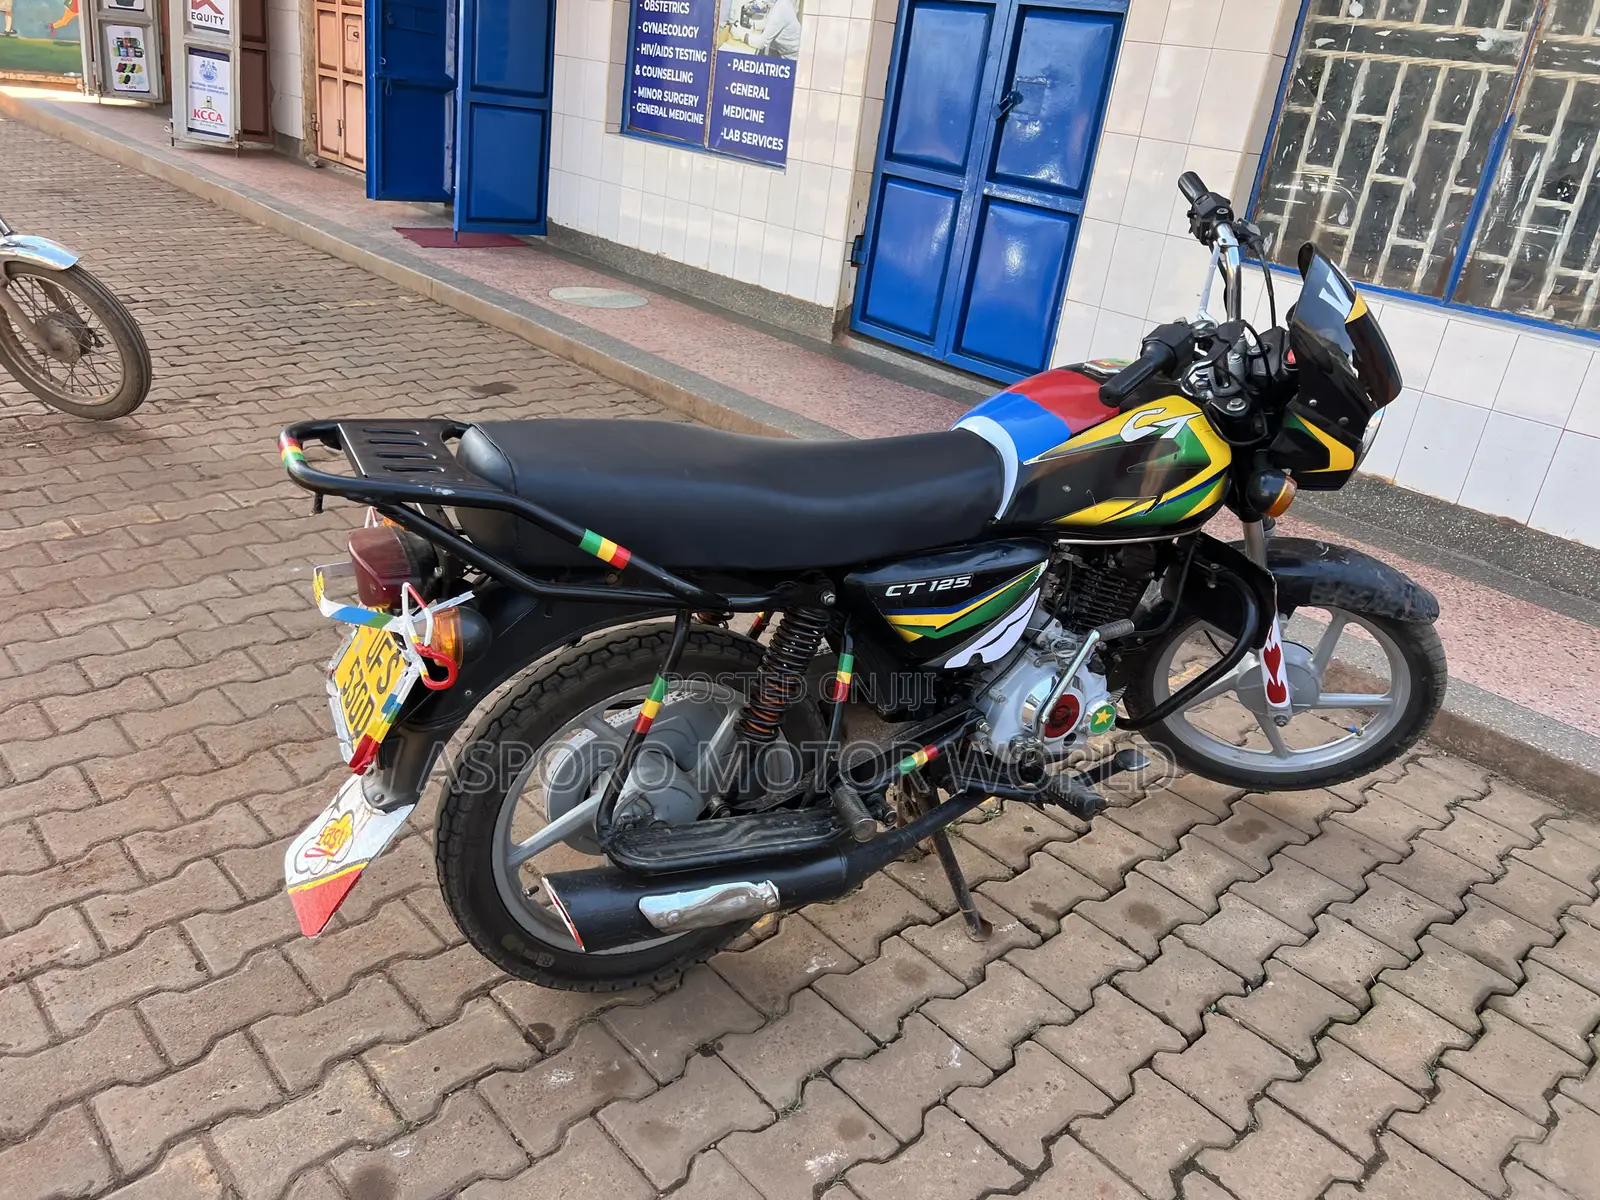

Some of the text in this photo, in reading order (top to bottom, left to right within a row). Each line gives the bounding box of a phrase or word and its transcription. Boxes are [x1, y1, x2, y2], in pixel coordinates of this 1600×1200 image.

[643, 0, 690, 15] OBSTETRICS
[191, 11, 225, 25] EQUITY
[642, 21, 699, 39] GYNAECOLOGY
[640, 43, 707, 63] HIV/AIDS TESTING
[634, 64, 694, 84] & COUNSELLING
[732, 58, 791, 79] PAEDIATRICS
[637, 86, 700, 108] MINOR SURGERY
[730, 82, 771, 101] GENERAL
[193, 109, 223, 123] KCCA
[636, 102, 704, 125] GENERAL MEDICINE
[722, 104, 766, 124] MEDICINE
[741, 130, 784, 151] SERVICES
[1119, 406, 1205, 443] CT
[884, 574, 973, 598] CT 125
